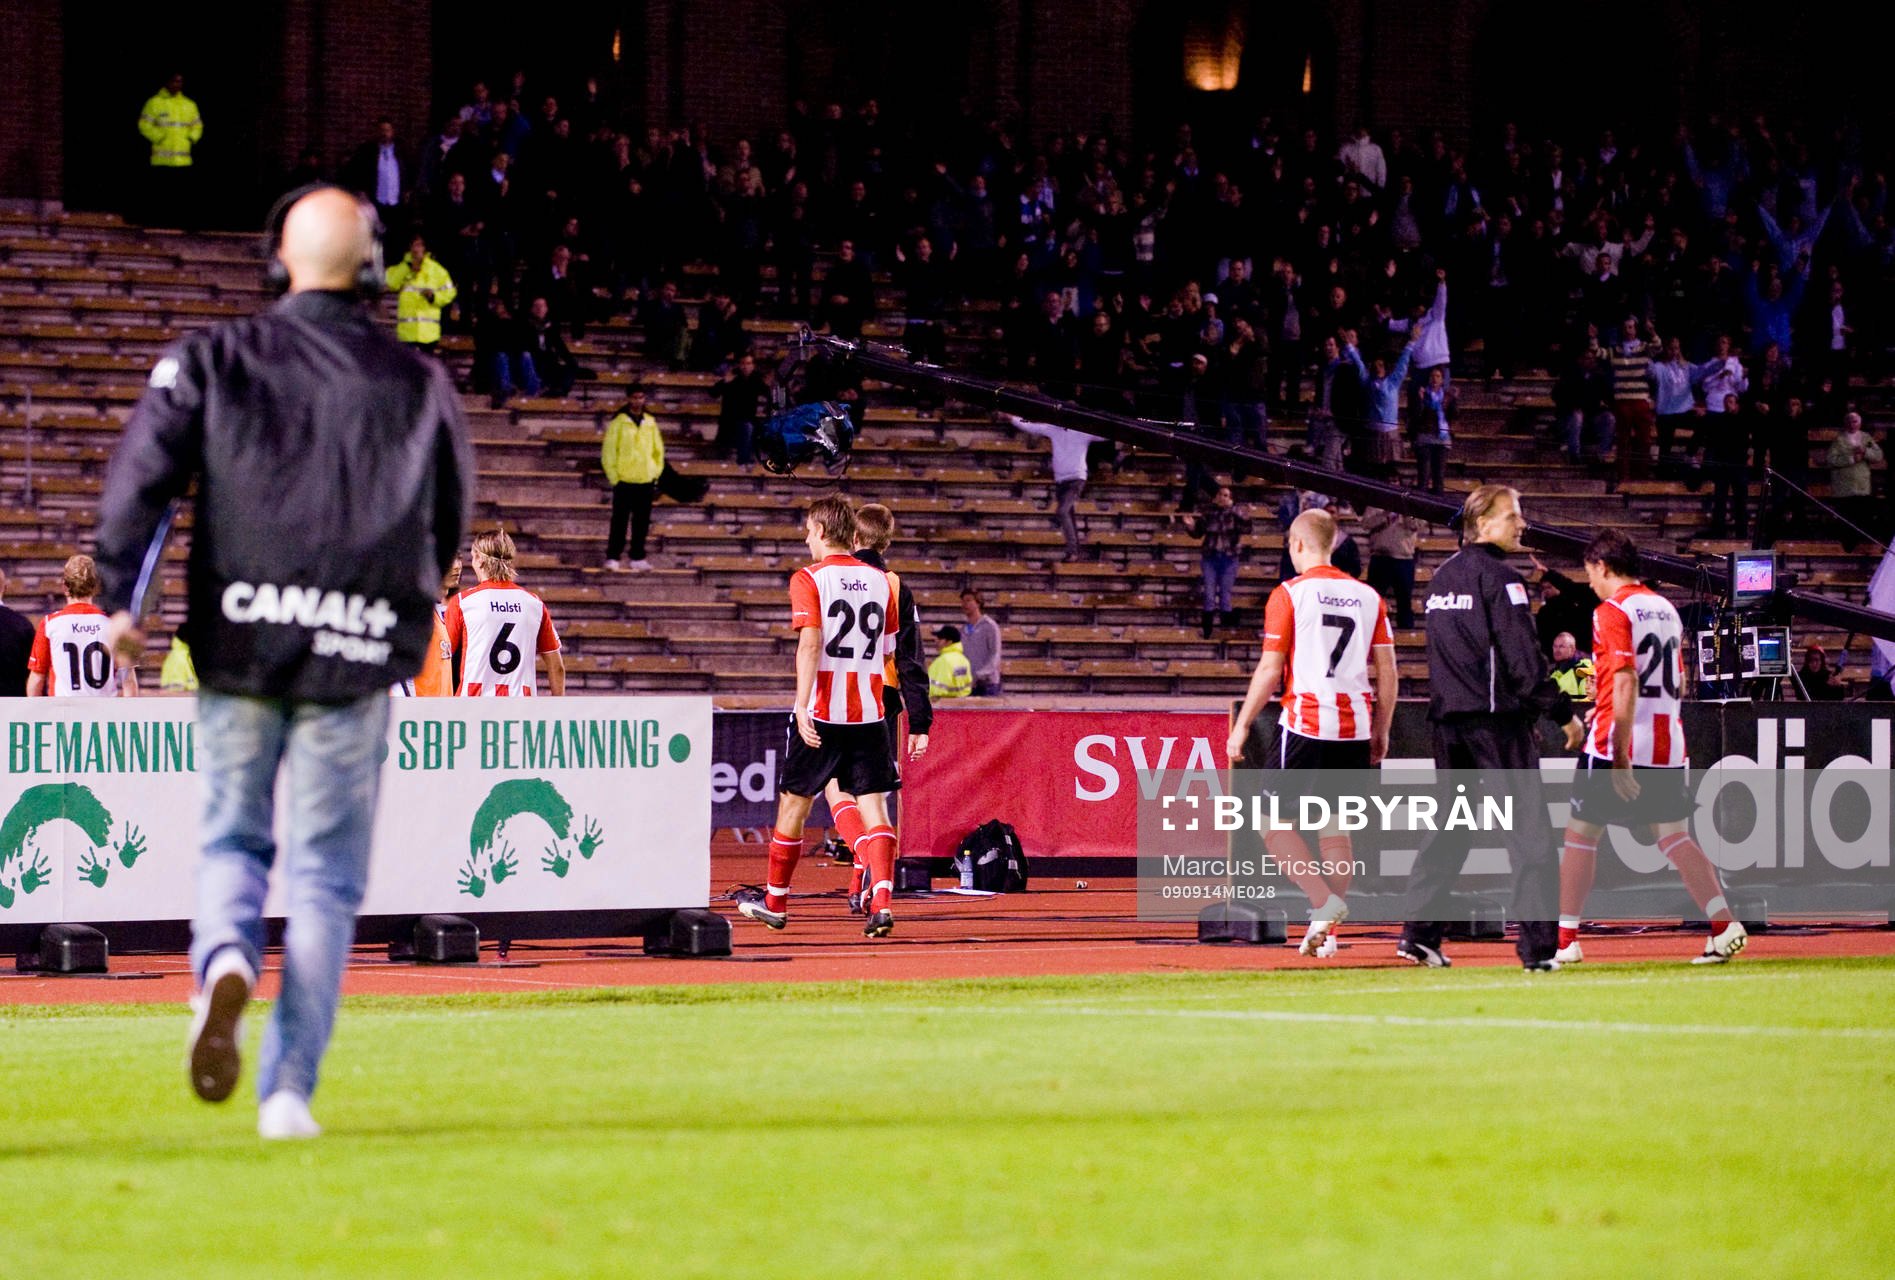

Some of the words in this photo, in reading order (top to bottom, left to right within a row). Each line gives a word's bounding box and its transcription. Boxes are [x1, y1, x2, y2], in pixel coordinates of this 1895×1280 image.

[221, 581, 398, 638] CANAL+
[490, 601, 521, 613] Halsti
[1317, 592, 1362, 608] Larsson
[72, 623, 101, 634] Kruys
[489, 622, 521, 675] 6
[825, 599, 884, 660] 29
[1322, 614, 1355, 678] 7
[63, 641, 111, 690] 10
[1636, 632, 1680, 700] 20
[399, 720, 466, 770] SBP
[480, 719, 660, 770] BEMANNING
[1074, 735, 1223, 801] SVA
